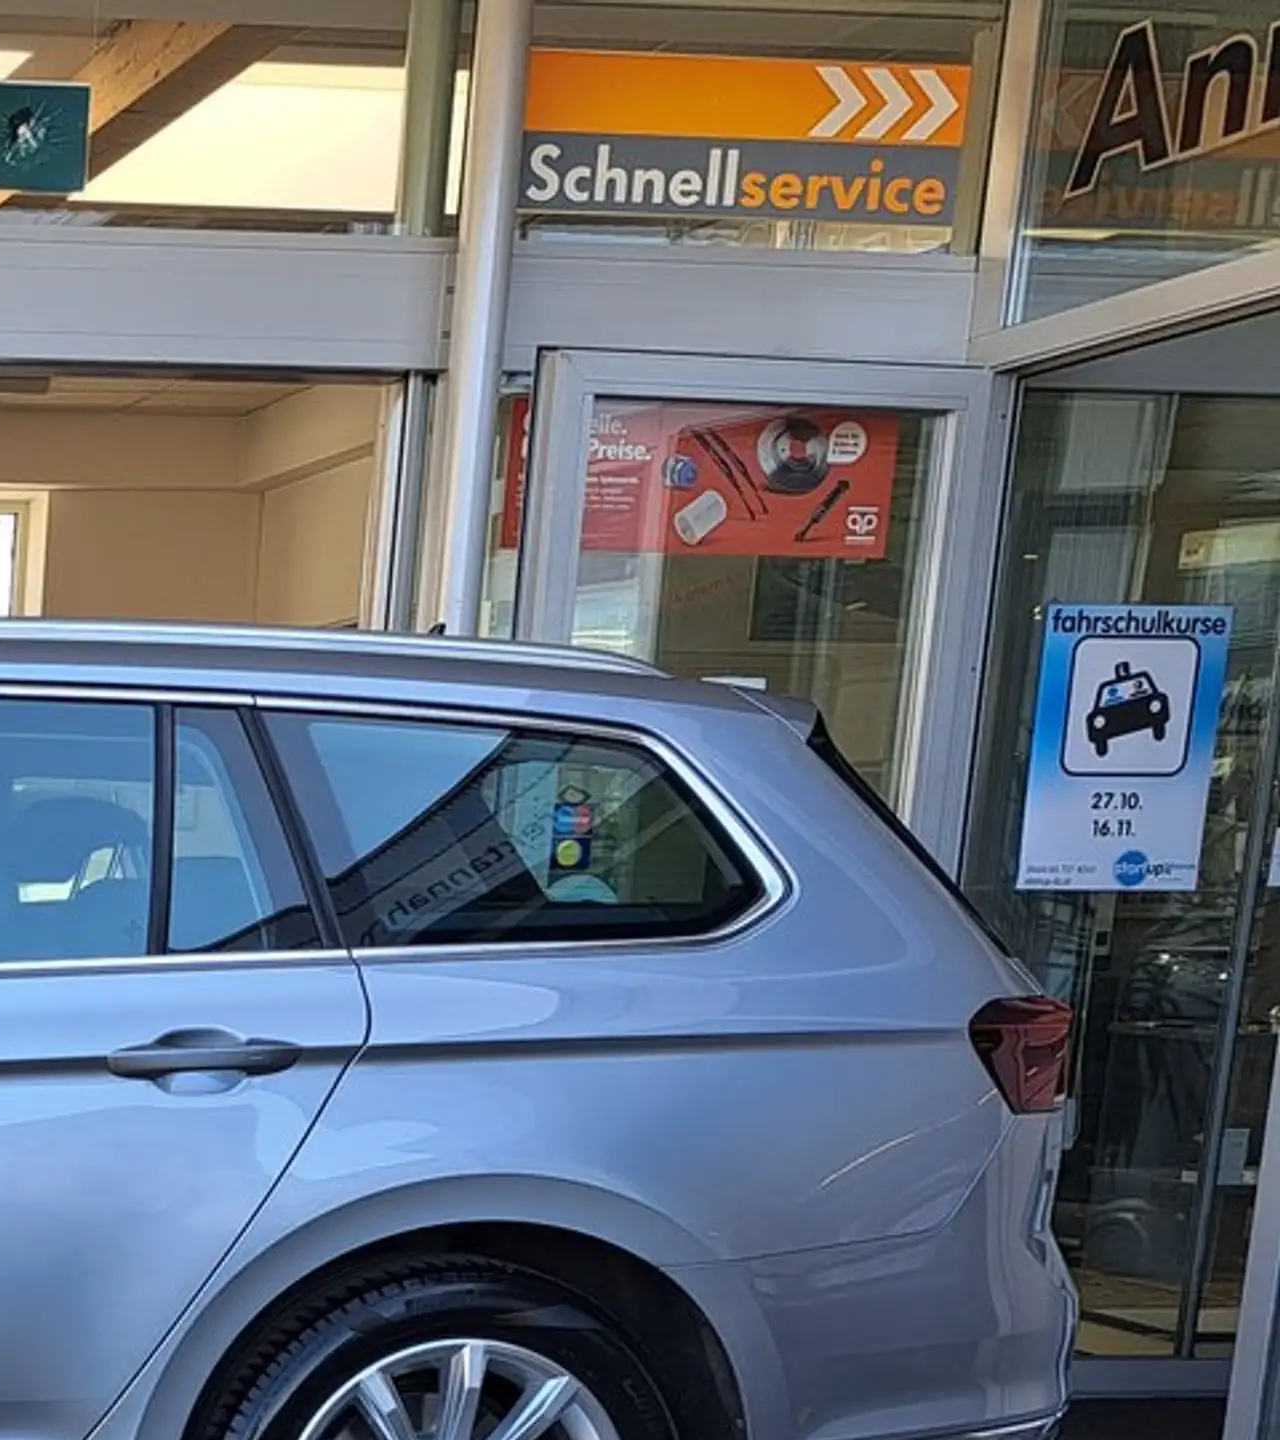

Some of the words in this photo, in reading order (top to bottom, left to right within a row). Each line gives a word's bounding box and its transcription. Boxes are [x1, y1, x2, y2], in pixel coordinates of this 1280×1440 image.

[1064, 16, 1280, 200] An
[526, 143, 947, 215] Schnellservice
[1051, 610, 1227, 635] fahrschulkurse
[1091, 793, 1143, 810] 27.10.
[1092, 819, 1136, 838] 16.11.
